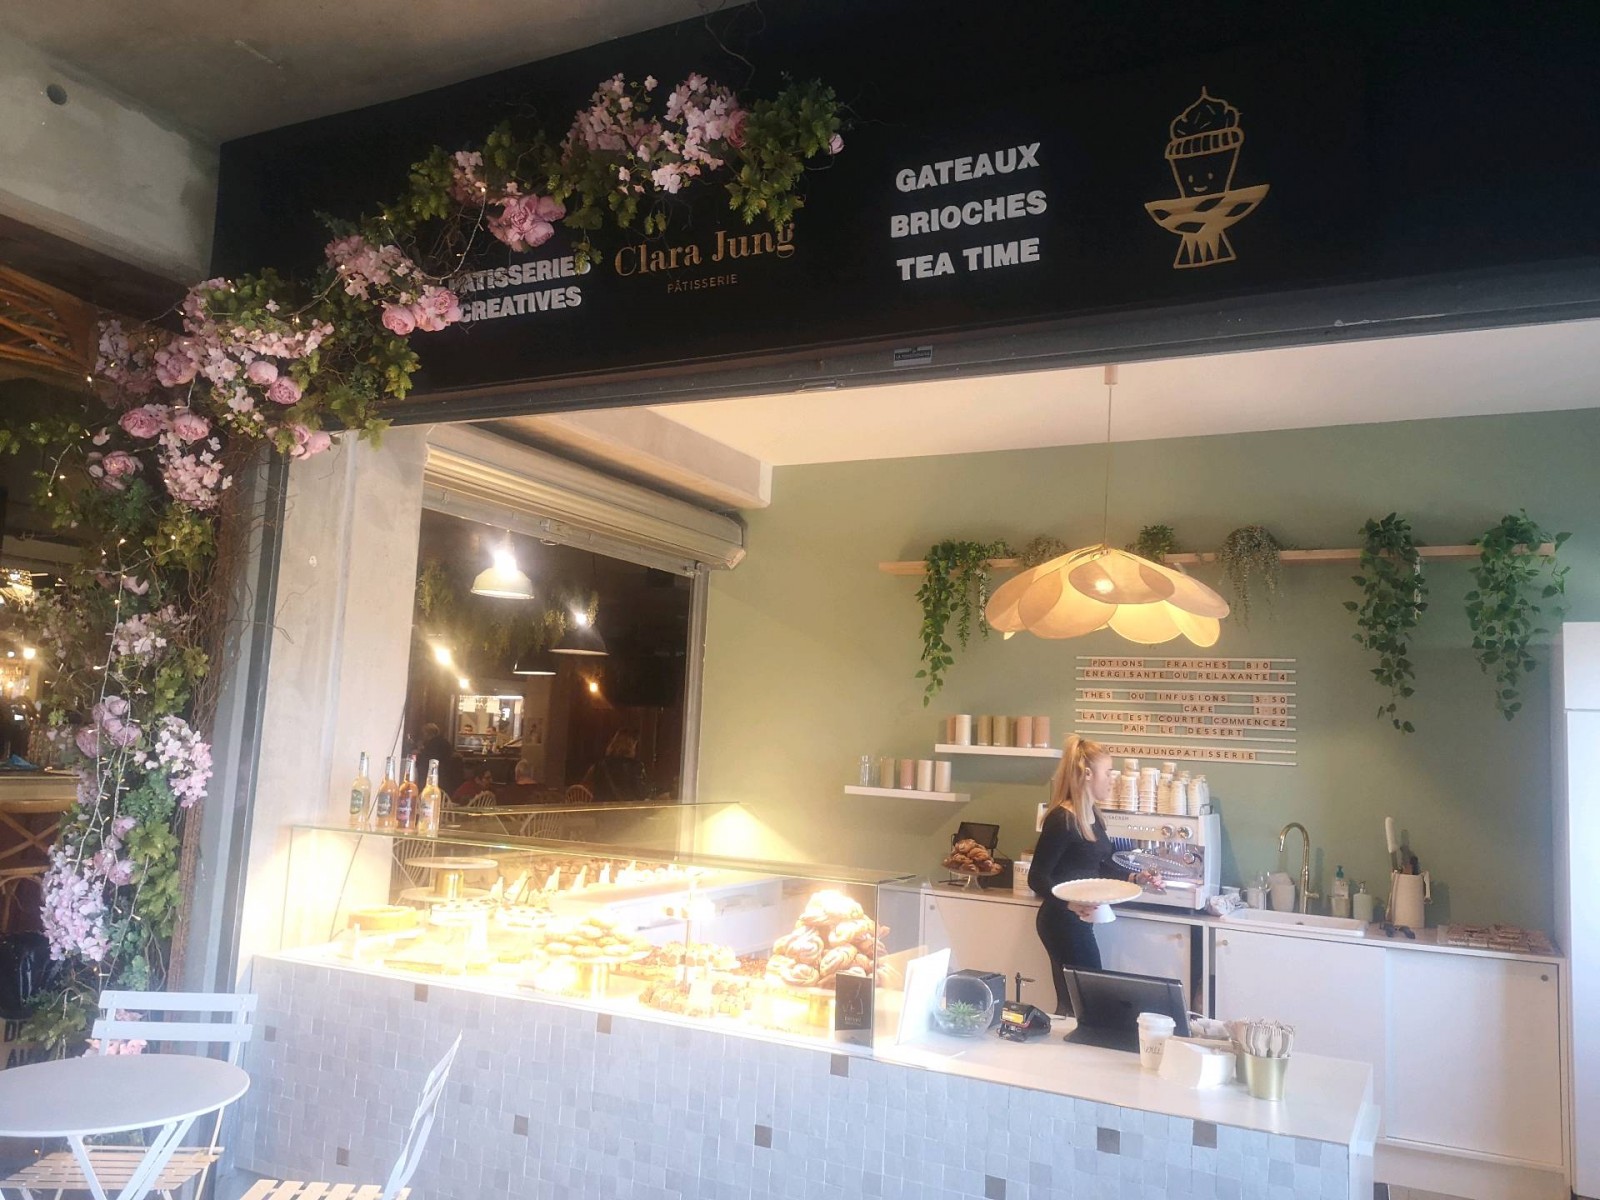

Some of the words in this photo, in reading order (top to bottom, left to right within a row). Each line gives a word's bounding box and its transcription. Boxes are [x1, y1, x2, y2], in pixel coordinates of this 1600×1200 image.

[895, 142, 1041, 193] GATEAUX
[890, 189, 1048, 239] BRIOCHES
[614, 240, 703, 278] Clara
[711, 222, 796, 263] Jung
[896, 252, 956, 281] TEA
[962, 237, 1041, 272] TIME
[459, 285, 582, 323] CREATIVES
[1085, 670, 1165, 679] ENERGISANTE
[1198, 672, 1268, 681] RELAXANTE
[1092, 660, 1143, 668] POTIONS
[1159, 692, 1226, 702] INFUSIONS
[1158, 715, 1203, 724] COURTE
[1213, 717, 1286, 727] COMMENCEZ
[1188, 728, 1242, 736] DESSERT
